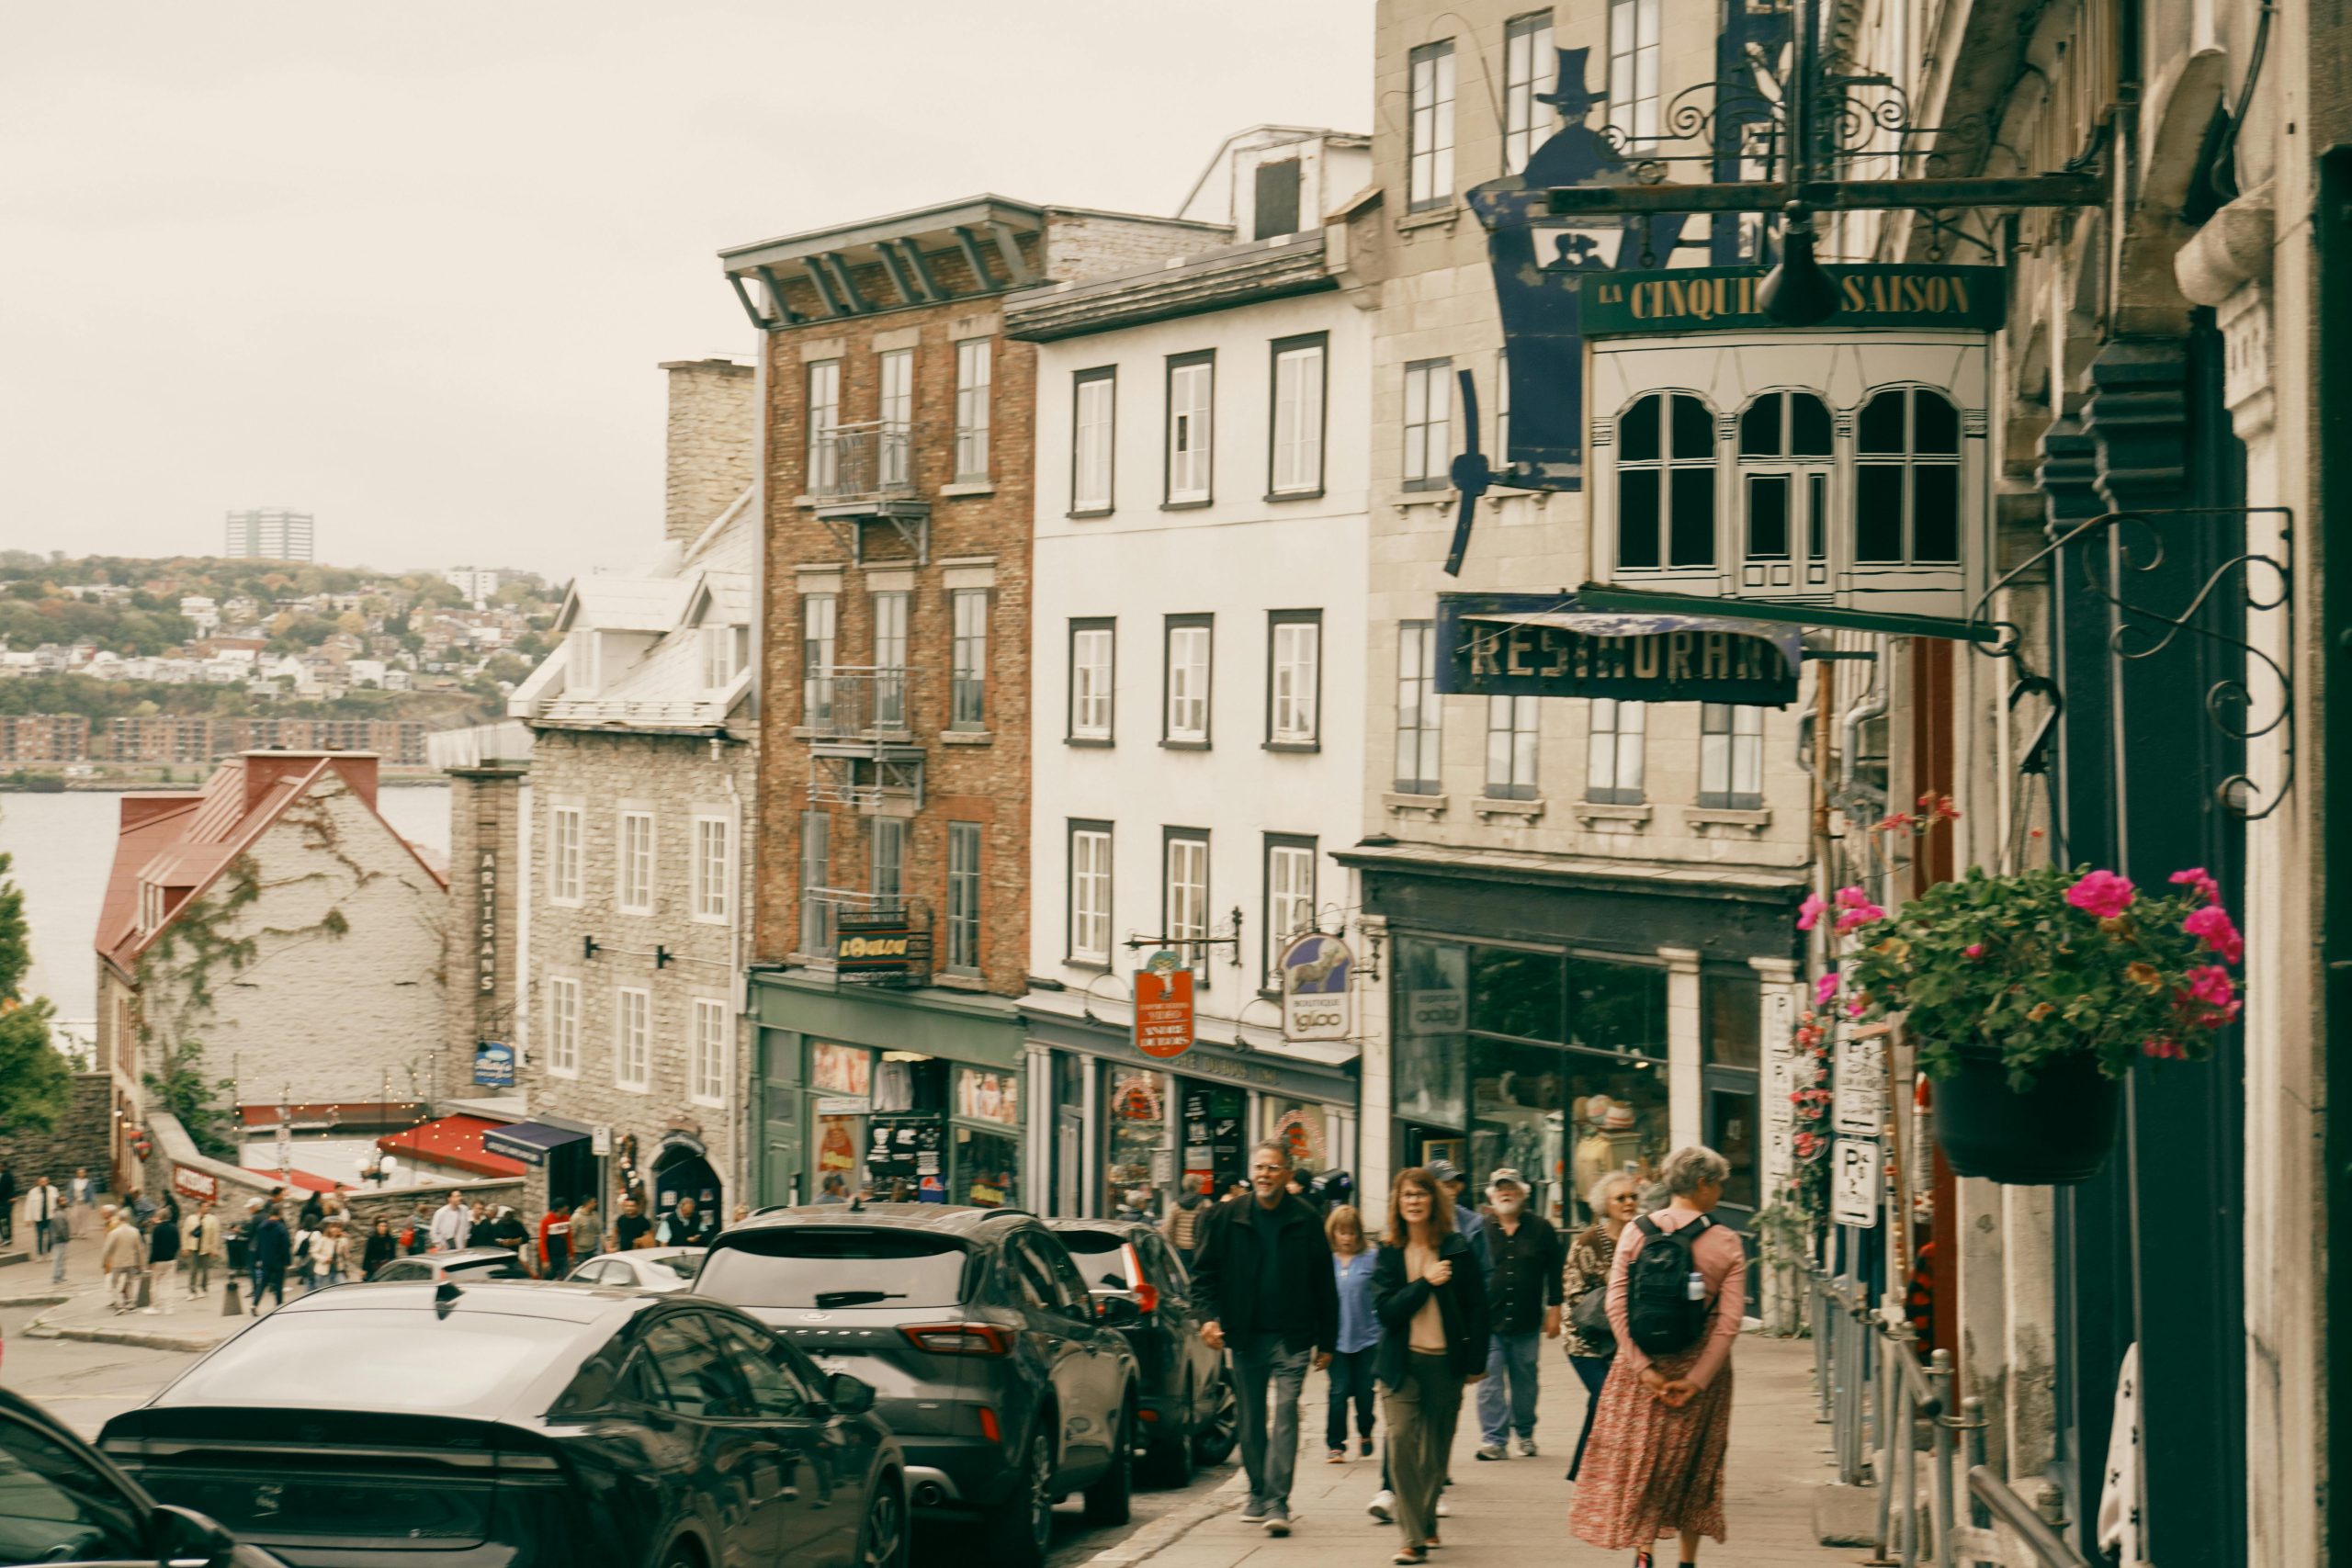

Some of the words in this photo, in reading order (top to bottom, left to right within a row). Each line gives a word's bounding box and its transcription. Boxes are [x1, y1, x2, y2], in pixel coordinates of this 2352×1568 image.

[1599, 284, 1623, 304] LA
[1630, 270, 1763, 321] CINQUI
[1841, 275, 1970, 313] SAISON
[481, 853, 495, 990] ARTISANS
